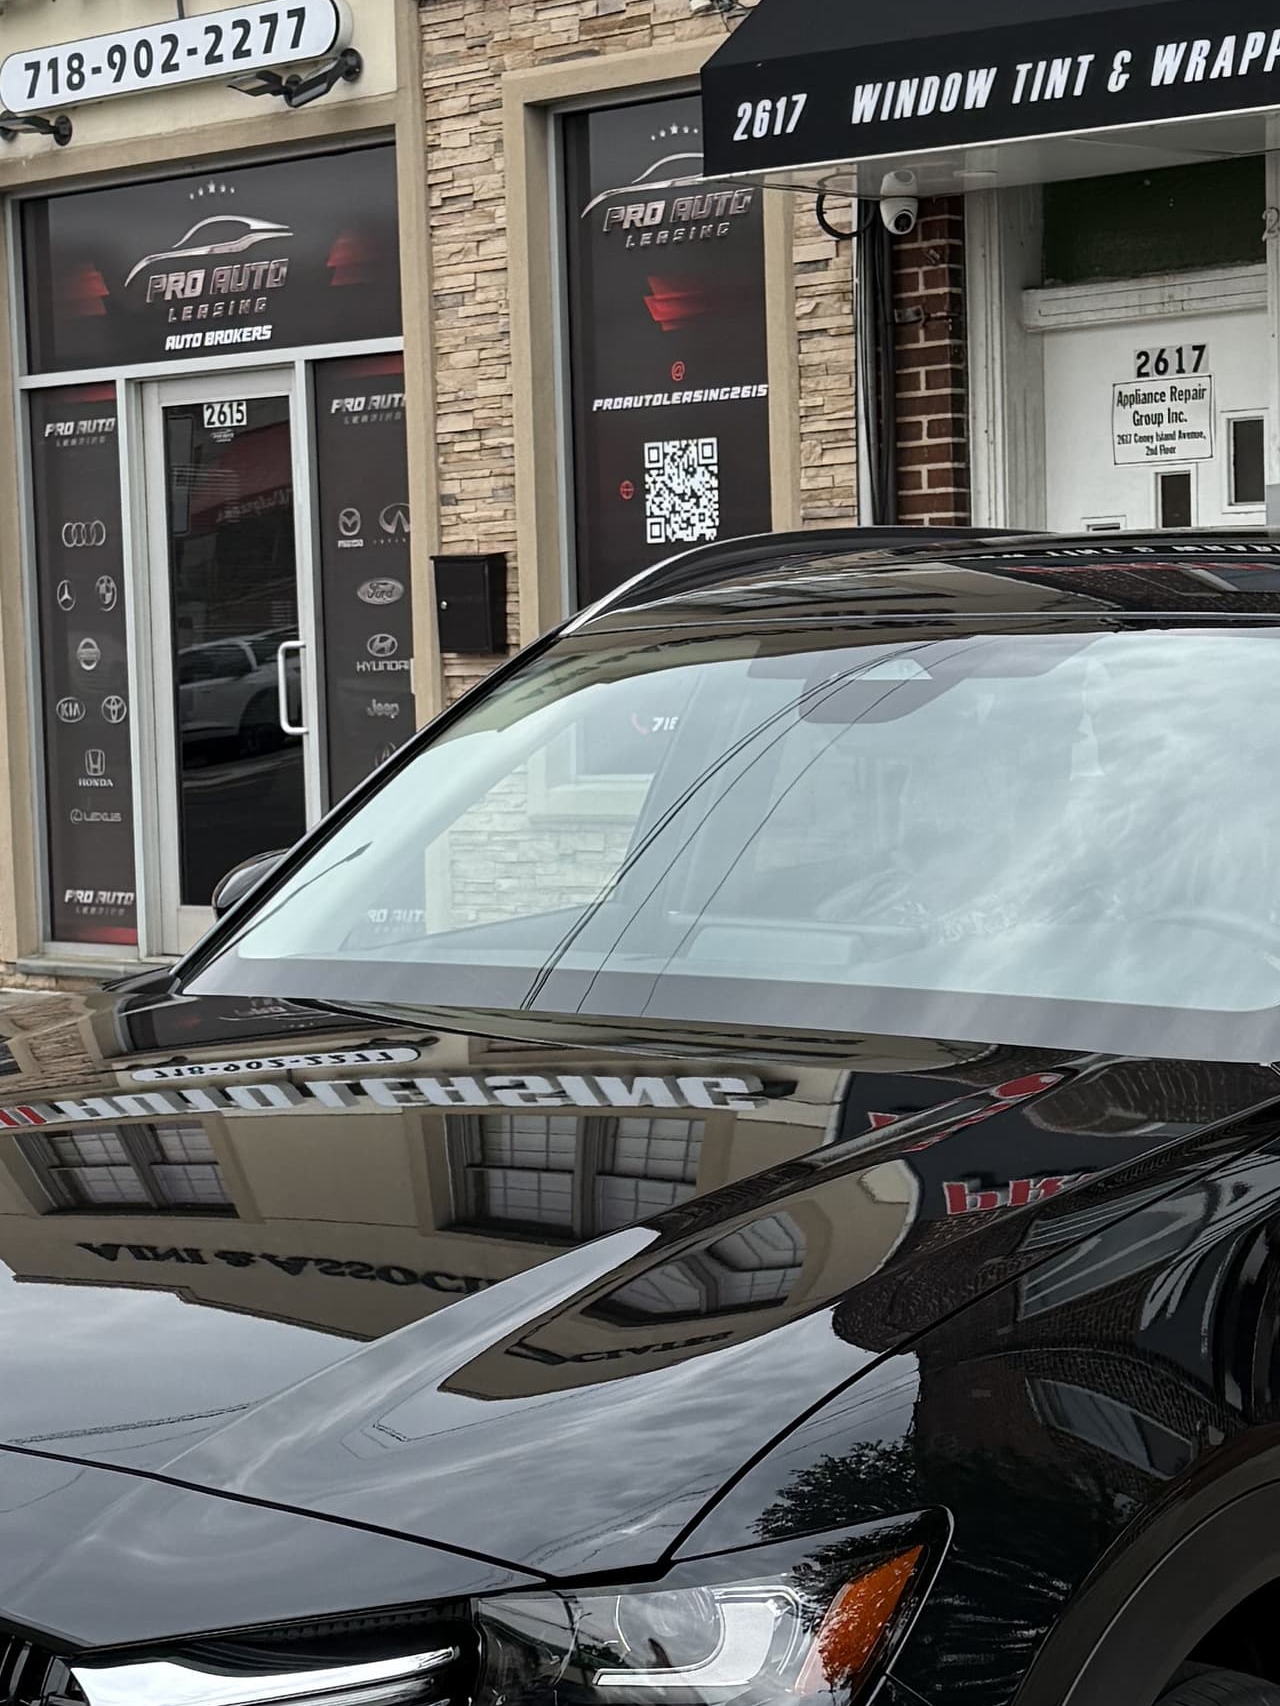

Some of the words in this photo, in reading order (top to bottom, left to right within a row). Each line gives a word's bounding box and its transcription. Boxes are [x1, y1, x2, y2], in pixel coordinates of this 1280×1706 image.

[23, 6, 308, 100] 718-902-2277
[732, 93, 808, 141] 2617
[851, 67, 997, 124] WINDOW
[1011, 53, 1095, 104] TINT
[1107, 50, 1131, 92] &
[603, 199, 666, 232] PRO
[670, 187, 755, 223] AUTO
[625, 222, 731, 249] LEASING
[146, 269, 205, 303] PRO
[209, 258, 289, 295] AUTO
[168, 296, 267, 323] LEASING
[165, 332, 202, 350] AUTO
[204, 324, 272, 347] BROKERS
[1136, 344, 1206, 378] 2617
[331, 396, 366, 413] PRO
[592, 384, 769, 412] PROAUTOLEASING2615
[1116, 388, 1166, 409] Appliance
[1170, 384, 1207, 404] Repair
[206, 401, 245, 426] 2615
[1133, 410, 1164, 427] Group
[1168, 407, 1188, 424] Inc.
[44, 421, 74, 437] PRO
[76, 417, 116, 434] AUTO
[61, 703, 81, 717] KIA
[367, 699, 399, 718] Jeep
[78, 778, 114, 788] HONDA
[64, 889, 94, 903] PRO
[95, 891, 135, 905] AUTO
